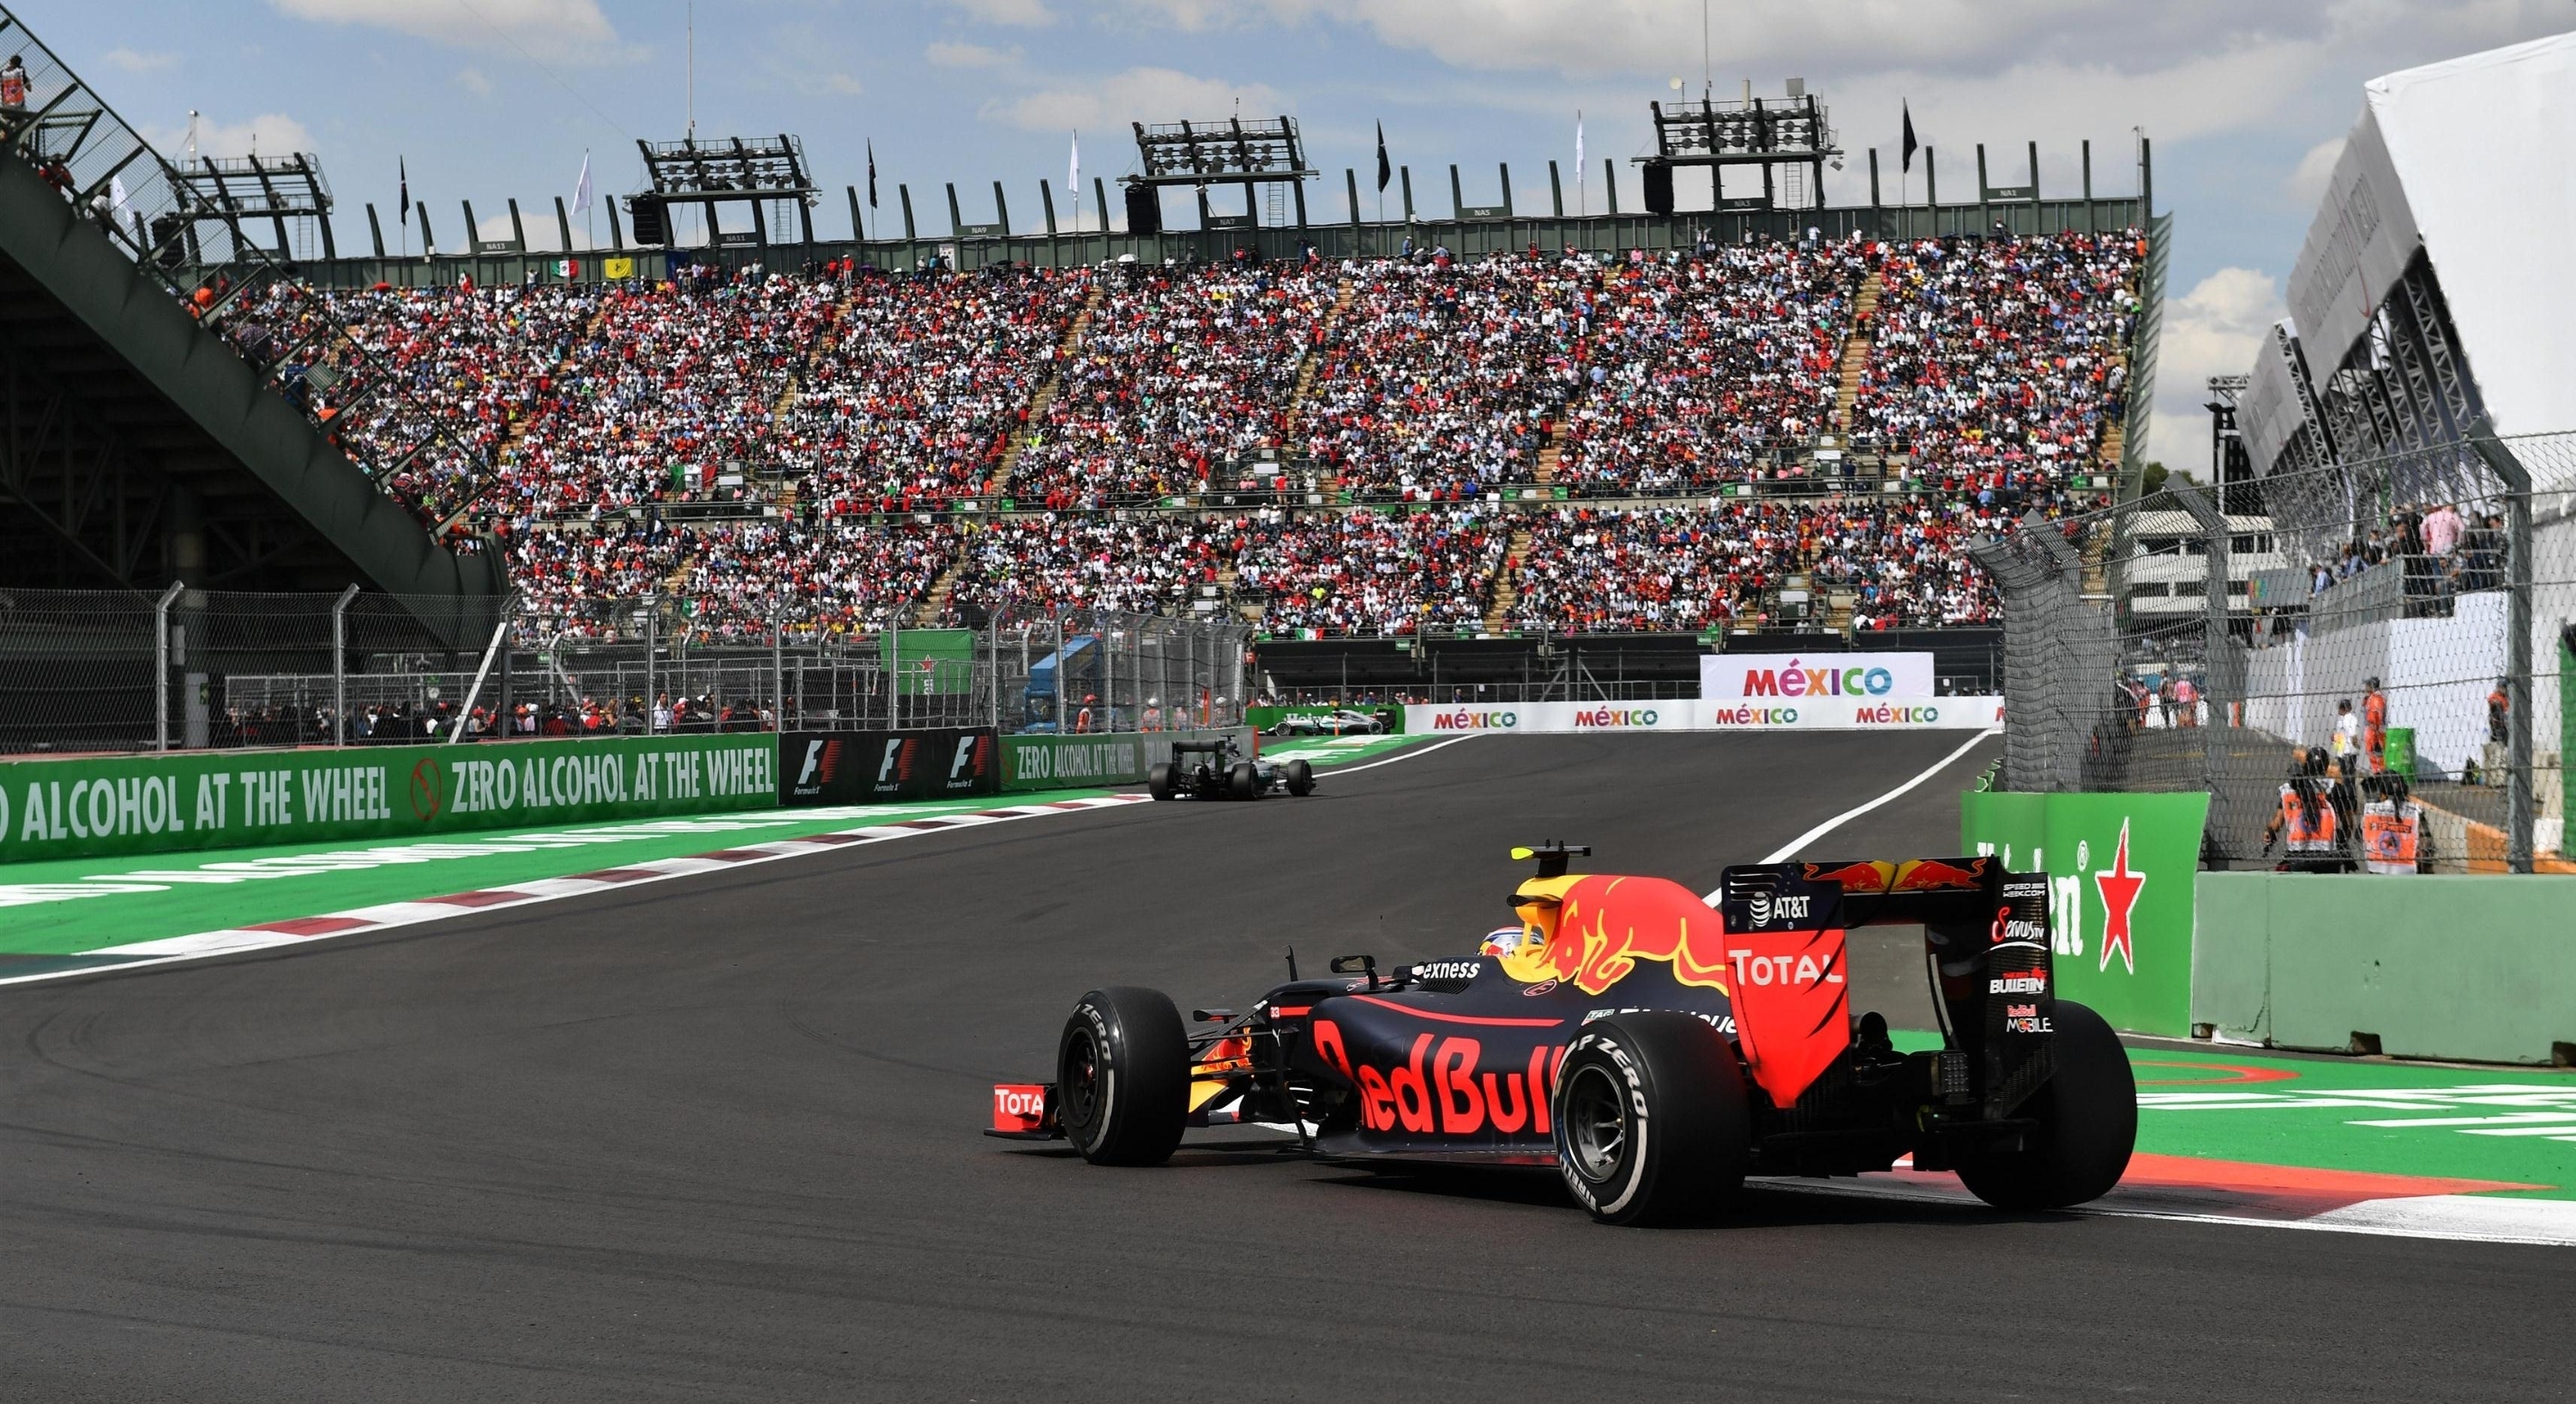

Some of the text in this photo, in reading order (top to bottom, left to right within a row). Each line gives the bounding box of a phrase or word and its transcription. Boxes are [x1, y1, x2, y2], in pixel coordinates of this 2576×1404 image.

[1017, 745, 1050, 779] ZERO
[1054, 744, 1092, 777] ALCOHOL
[1093, 744, 1102, 776] AT
[451, 748, 775, 813] ZERO ALCOHOL AT THE WHEEL
[21, 776, 184, 841] ALCOHOL
[195, 773, 230, 830] AT
[240, 770, 292, 827] THE
[302, 767, 391, 823] WHEEL
[1773, 896, 1810, 919] AT&T
[1423, 962, 1481, 979] exness
[1728, 949, 1844, 986] TOTAL
[1270, 1006, 1280, 1018] 33
[1082, 1003, 1111, 1061] ZERO
[1577, 1034, 1595, 1051] P
[1596, 1037, 1650, 1119] ZERO
[994, 1089, 1044, 1115] TOTA
